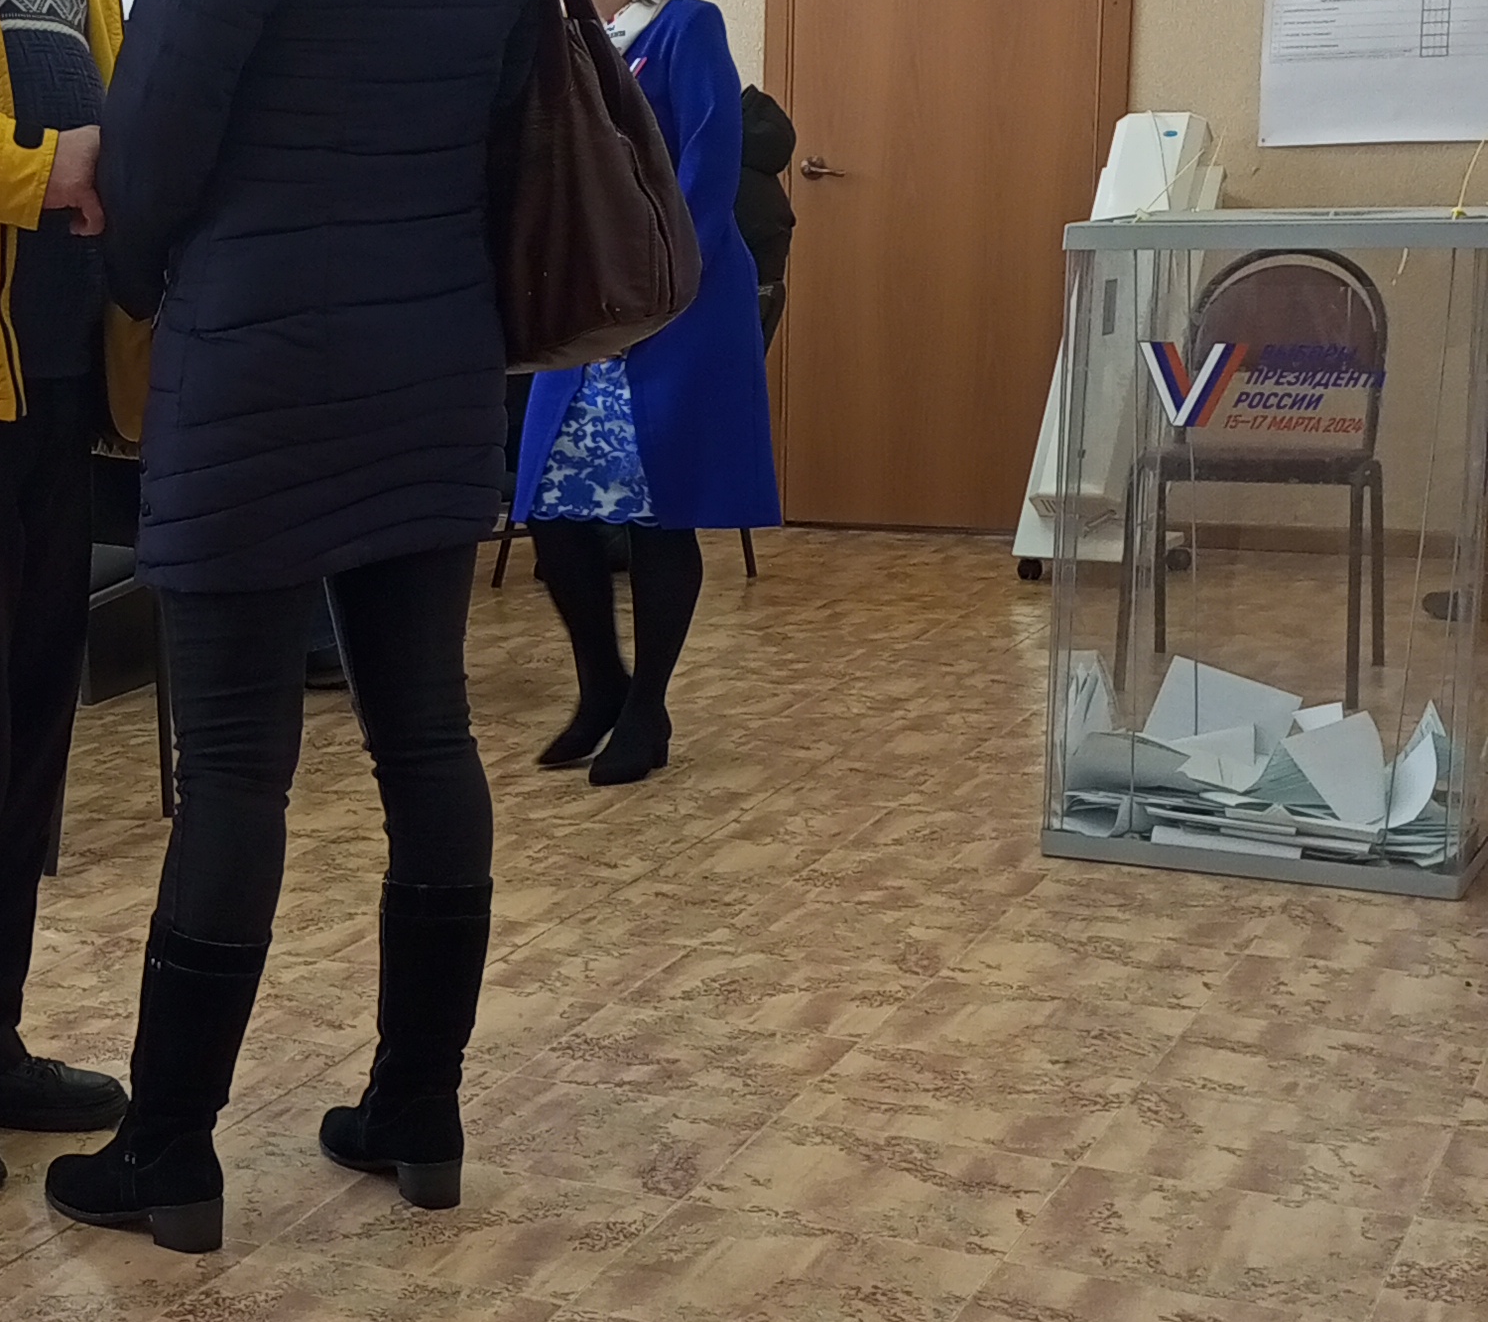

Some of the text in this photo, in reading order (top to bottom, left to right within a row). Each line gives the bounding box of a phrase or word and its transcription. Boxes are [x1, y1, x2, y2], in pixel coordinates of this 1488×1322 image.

[1245, 370, 1386, 389] ПРЕЗИДЕНТА
[1232, 392, 1324, 411] РОССИИ
[1268, 415, 1322, 432] МАРТА
[1323, 417, 1365, 433] 2024
